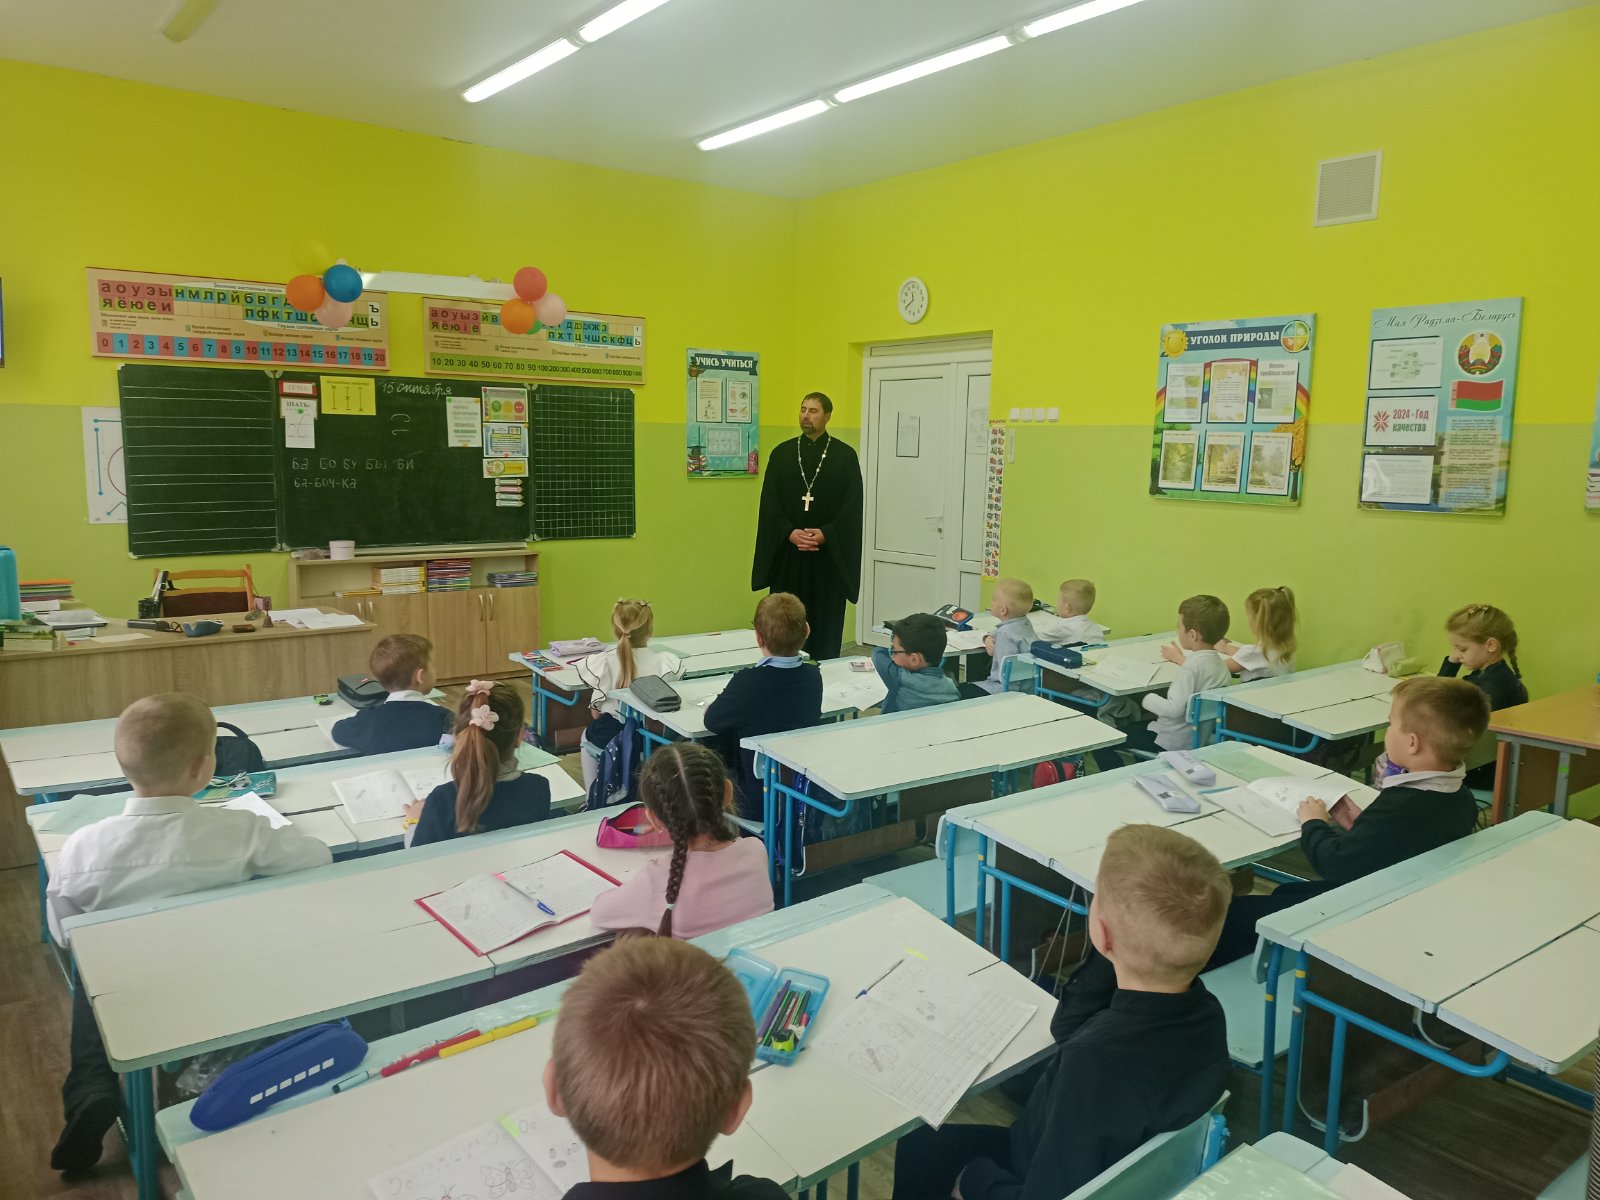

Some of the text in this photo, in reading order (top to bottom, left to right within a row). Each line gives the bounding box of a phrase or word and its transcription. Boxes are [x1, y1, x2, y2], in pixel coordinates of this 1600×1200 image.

[1190, 331, 1280, 344] УГОЛОК ПРИРОДЫ
[149, 341, 154, 349] 3
[207, 344, 213, 352] 7
[221, 345, 226, 353] 8
[261, 347, 270, 355] 11
[274, 348, 284, 356] 12
[287, 349, 297, 357] 13
[313, 350, 323, 358] 15
[338, 351, 348, 359] 17
[351, 352, 360, 360] 18
[375, 353, 385, 361] 20
[696, 357, 753, 368] УЧИСЬ УЧИТЬСЯ
[383, 382, 393, 394] 15
[1393, 409, 1410, 419] 2024
[1416, 409, 1429, 420] Год
[1393, 424, 1426, 432] качества
